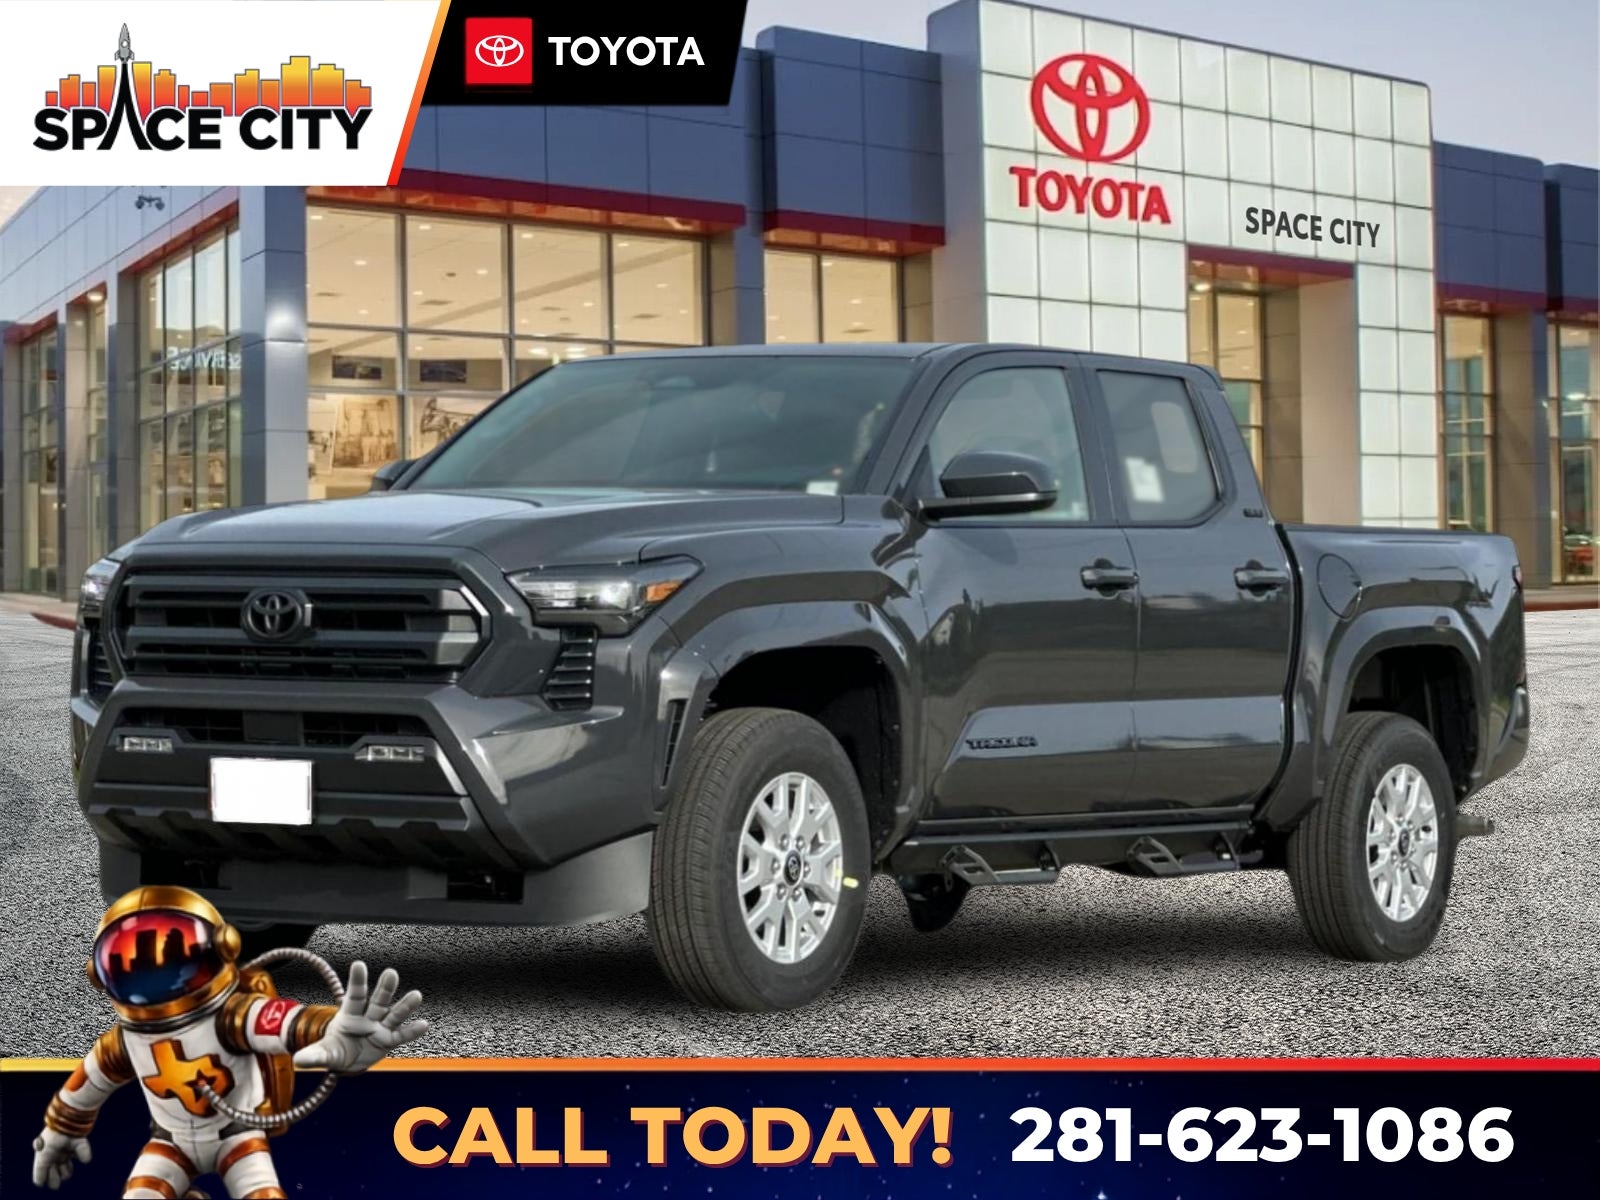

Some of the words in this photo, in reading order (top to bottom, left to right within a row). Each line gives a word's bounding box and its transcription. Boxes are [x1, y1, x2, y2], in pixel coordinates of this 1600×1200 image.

[1009, 166, 1171, 224] TOYOTA
[1245, 207, 1322, 241] SPACE
[1330, 218, 1380, 248] CITY
